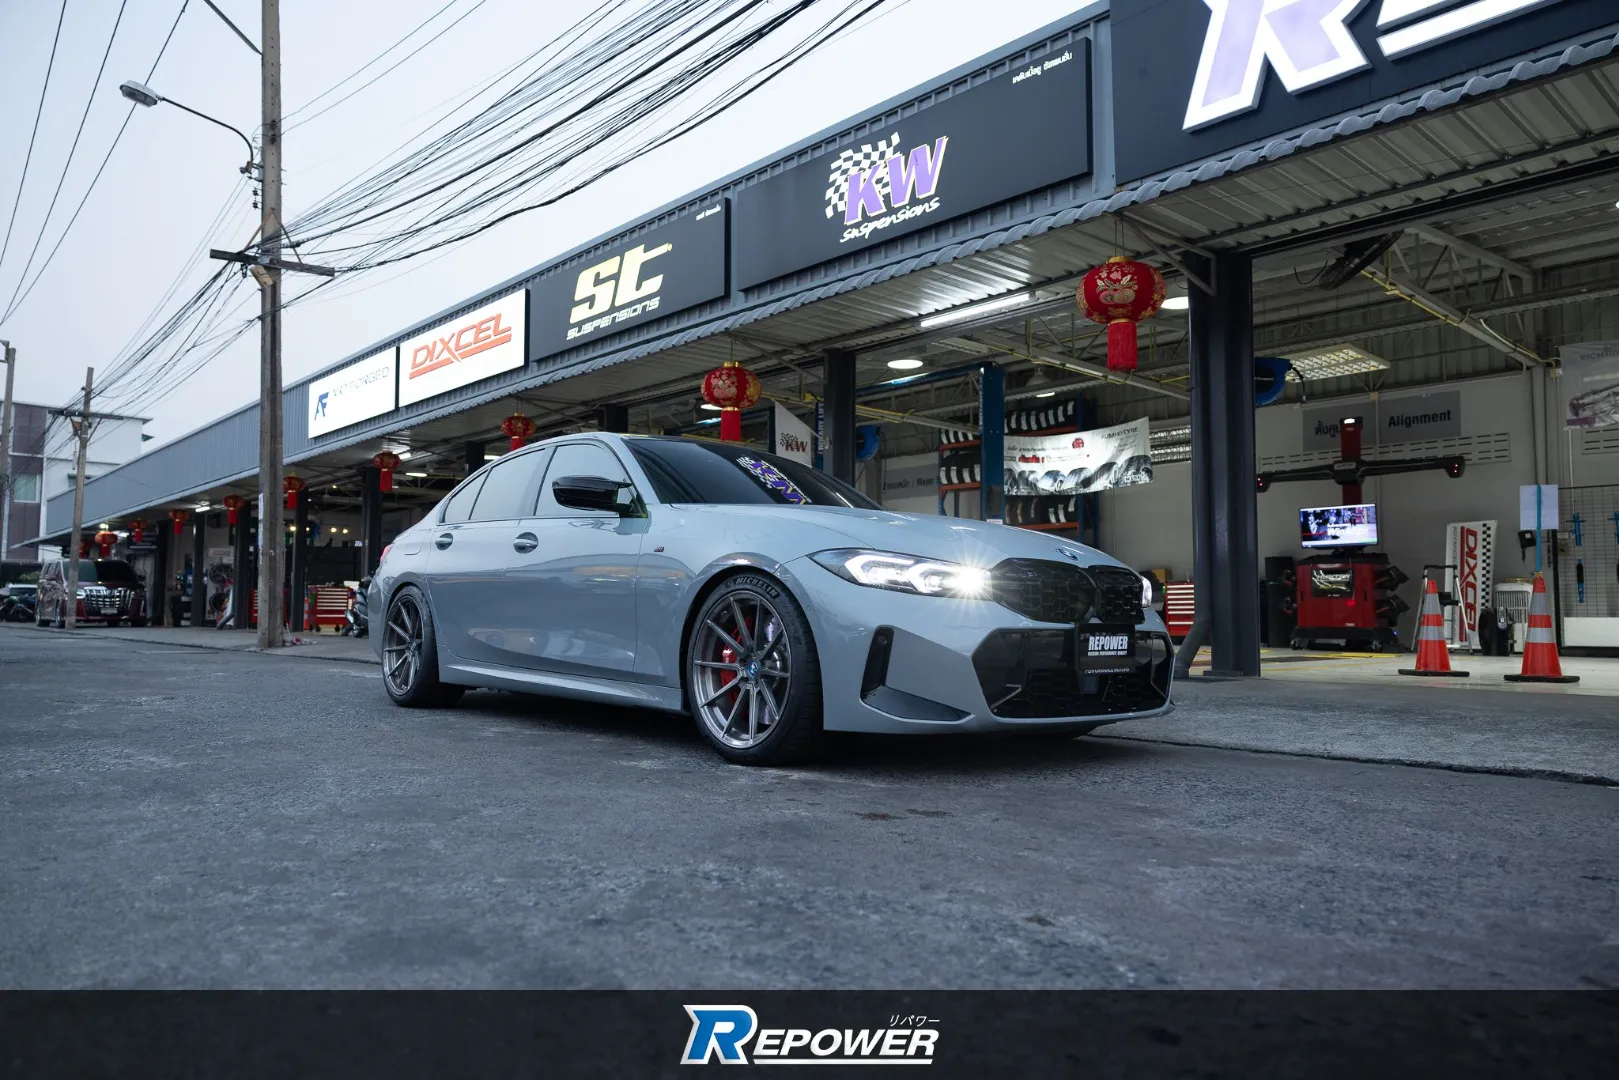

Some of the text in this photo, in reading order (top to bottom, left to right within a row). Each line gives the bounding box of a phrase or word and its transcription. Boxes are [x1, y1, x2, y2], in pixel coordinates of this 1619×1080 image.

[844, 136, 949, 225] KW
[840, 197, 940, 243] suspensions
[411, 313, 512, 370] DIXCEL
[1388, 409, 1452, 429] Alignment
[785, 439, 808, 453] KW
[735, 576, 779, 599] MICHELIN
[1088, 635, 1129, 651] REPOWER
